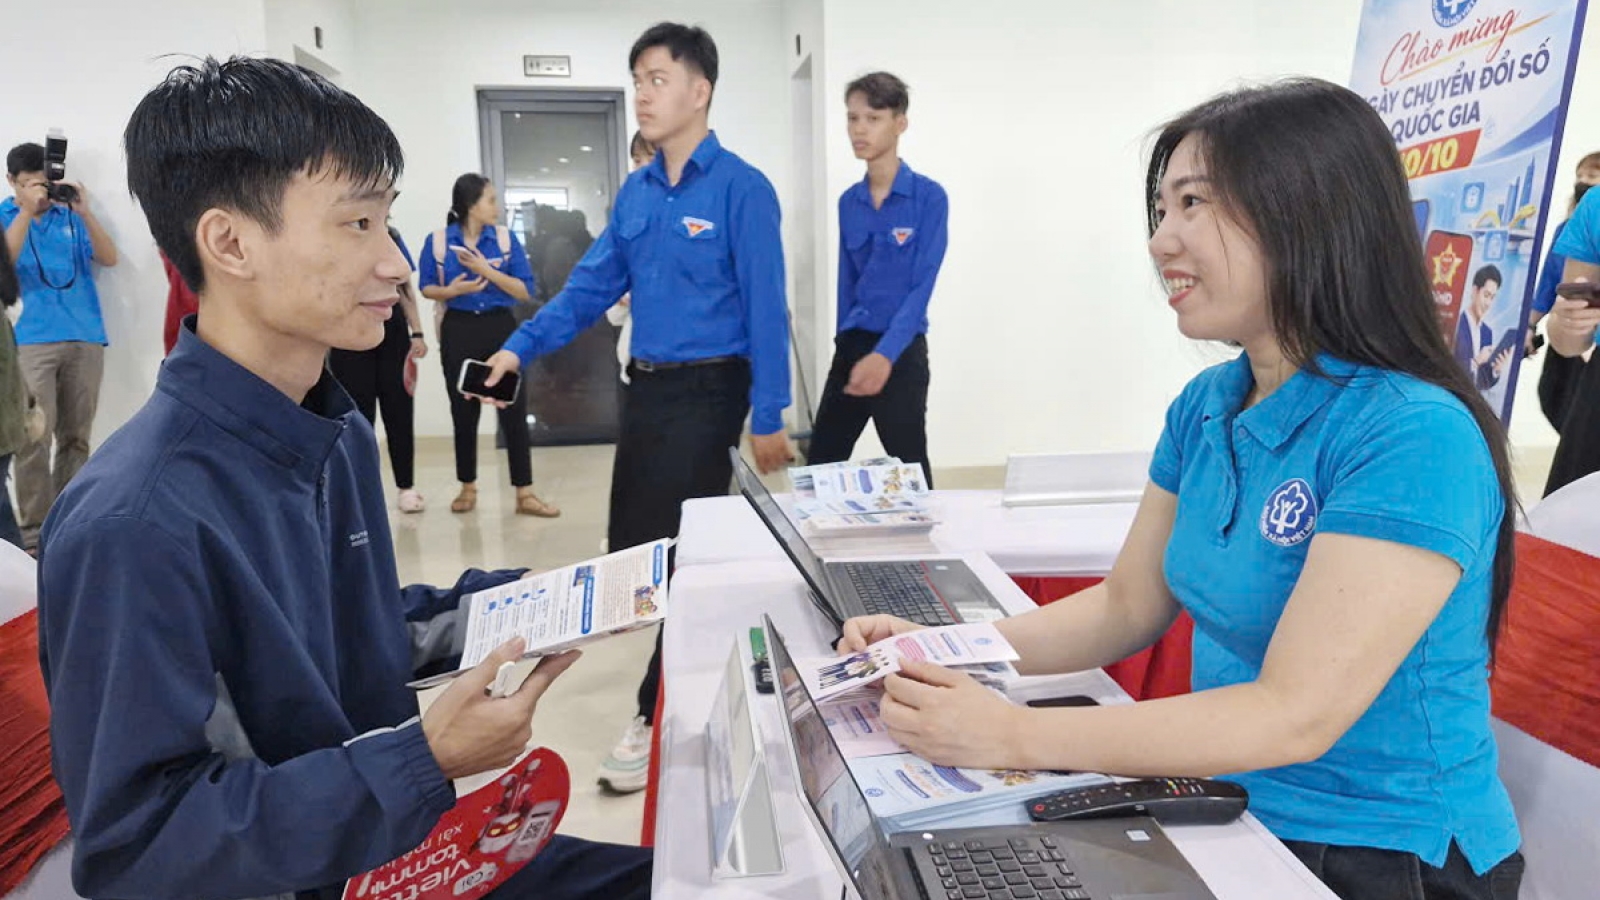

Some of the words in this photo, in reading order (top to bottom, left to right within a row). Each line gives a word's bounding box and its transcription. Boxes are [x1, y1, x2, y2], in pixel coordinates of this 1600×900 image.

[1380, 30, 1444, 86] Chào
[1448, 9, 1520, 63] mừng
[1366, 87, 1399, 114] GÀY
[1403, 60, 1475, 109] CHUYỂN
[1479, 49, 1515, 90] ĐỔI
[1518, 36, 1550, 79] SỐ
[1391, 102, 1444, 143] QUỐC
[1448, 101, 1480, 128] GIA
[1402, 137, 1458, 178] 0/10
[384, 859, 471, 900] viett
